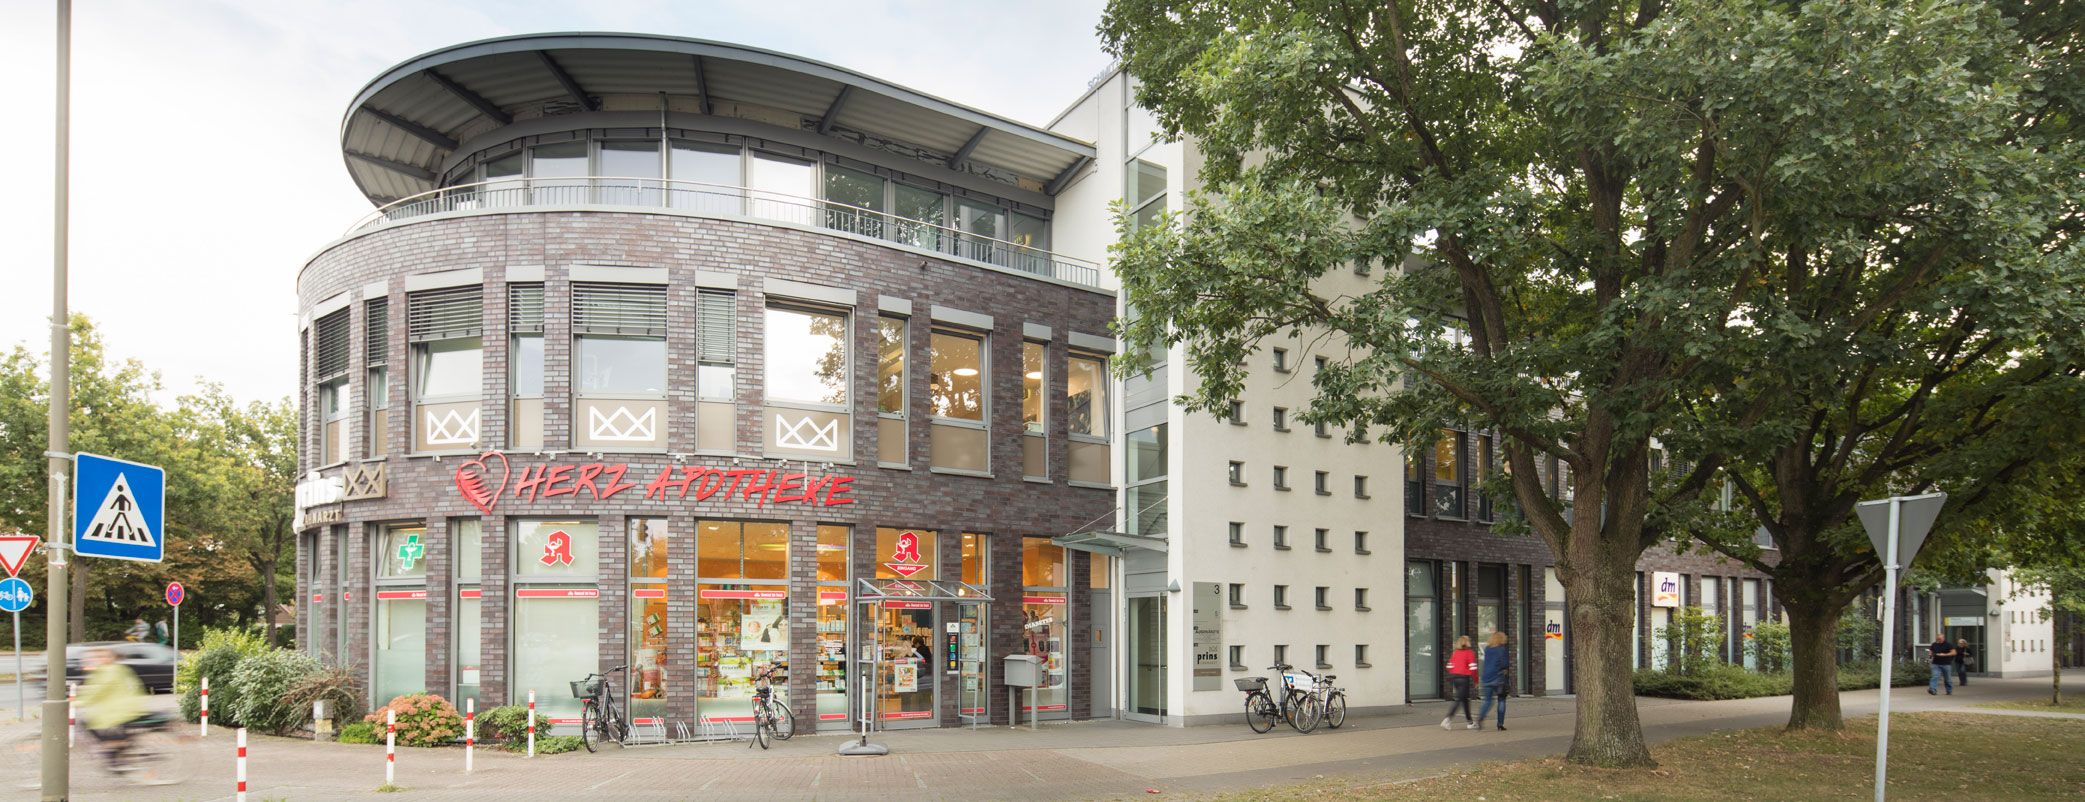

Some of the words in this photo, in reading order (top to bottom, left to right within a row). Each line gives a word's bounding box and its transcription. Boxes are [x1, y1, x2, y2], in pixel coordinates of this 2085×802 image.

[514, 463, 637, 503] HERZ
[646, 464, 856, 509] APOTHEKE
[1214, 584, 1220, 595] 3
[1661, 577, 1675, 592] dm
[1546, 619, 1560, 633] dm
[1197, 651, 1218, 664] prins
